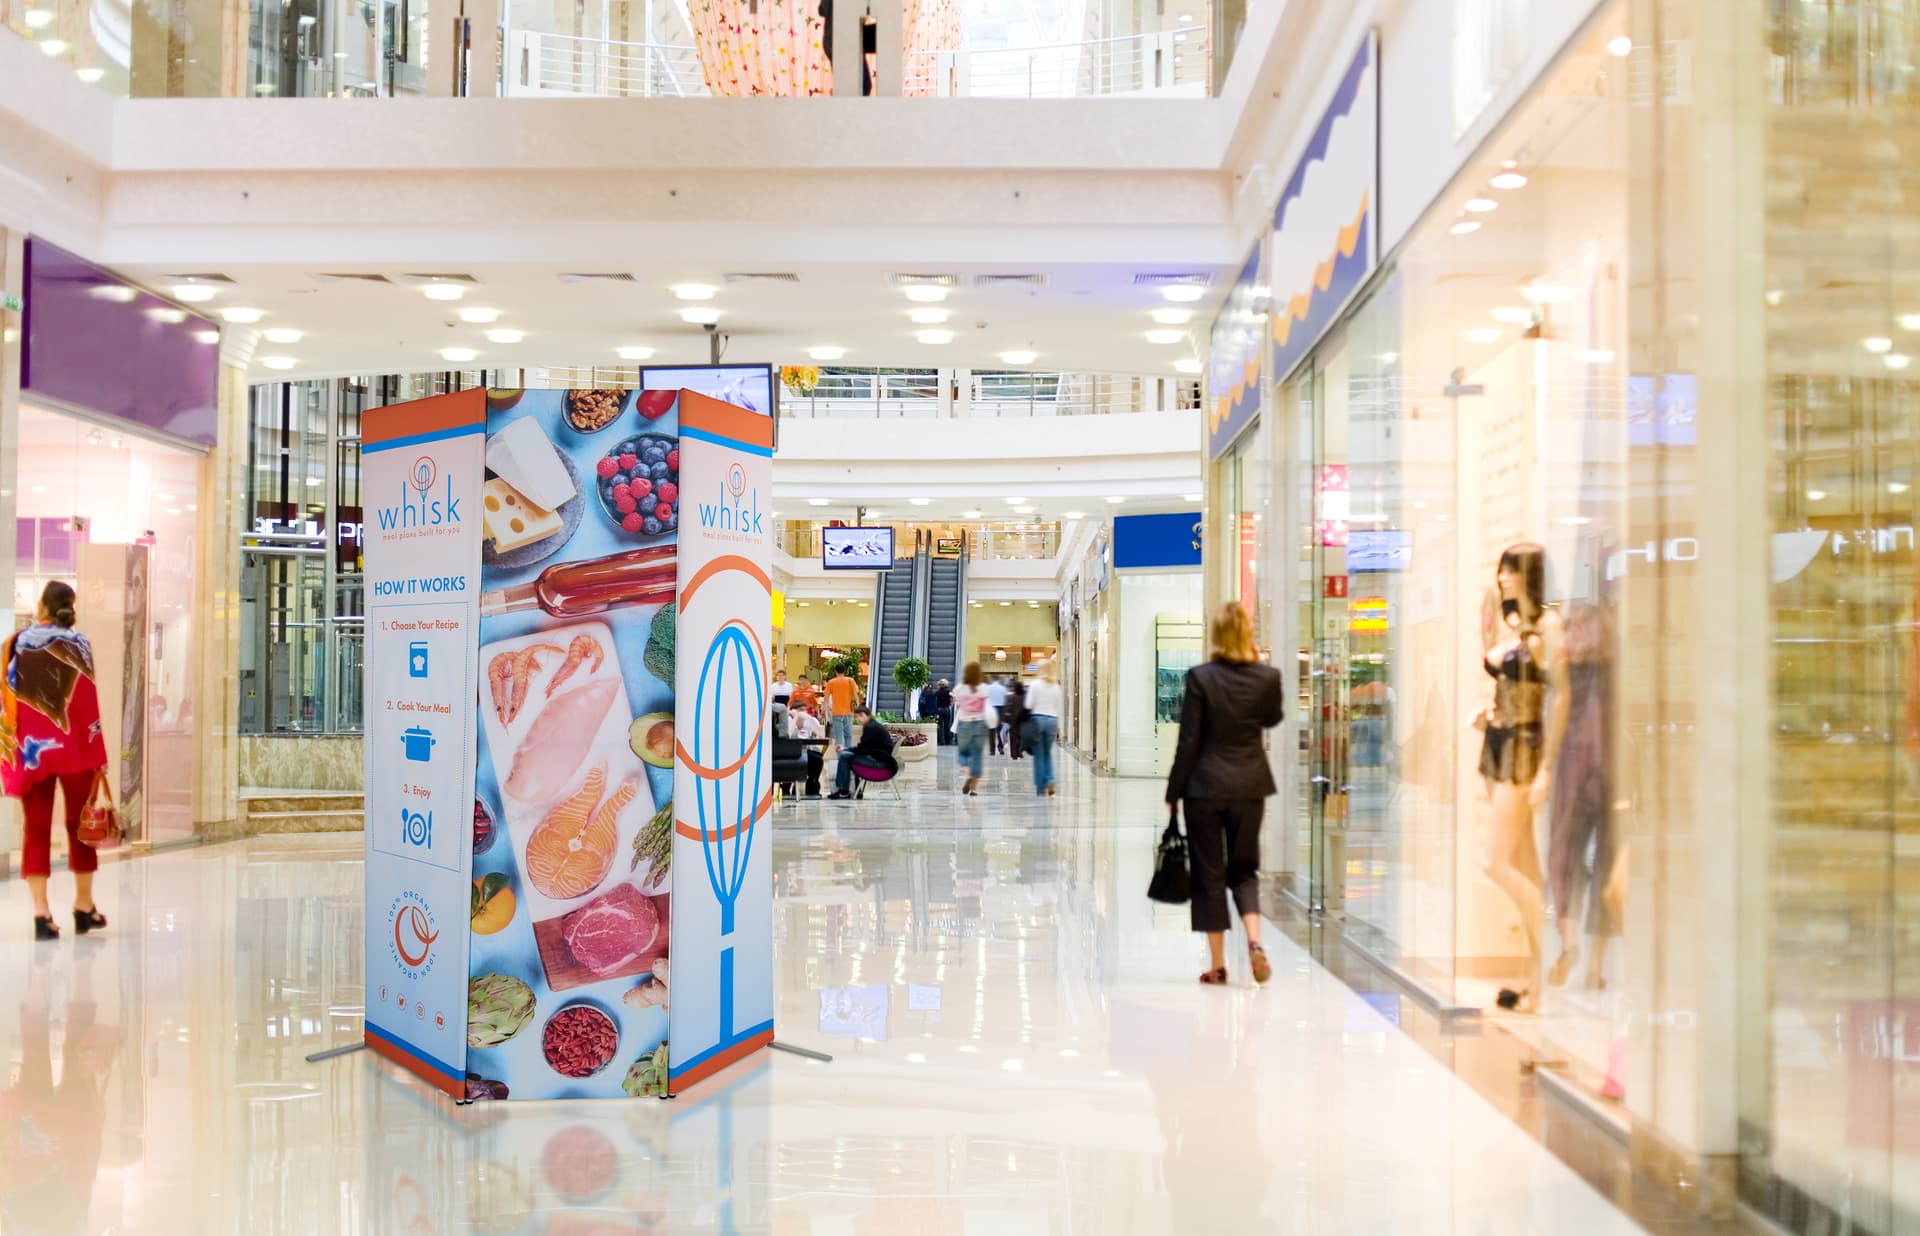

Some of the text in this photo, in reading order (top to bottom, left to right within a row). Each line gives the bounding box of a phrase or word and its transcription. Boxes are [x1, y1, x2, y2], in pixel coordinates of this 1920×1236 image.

[378, 473, 462, 530] whisk
[699, 481, 763, 534] whisk
[374, 576, 466, 596] HOW IT WORKS
[381, 619, 459, 632] 1. Choose Your Recipe
[386, 700, 451, 714] 2. Cook Your Meal
[403, 783, 431, 800] 3. Enjoy
[403, 890, 435, 925] ORGANIC
[389, 941, 418, 980] ORGANIC
